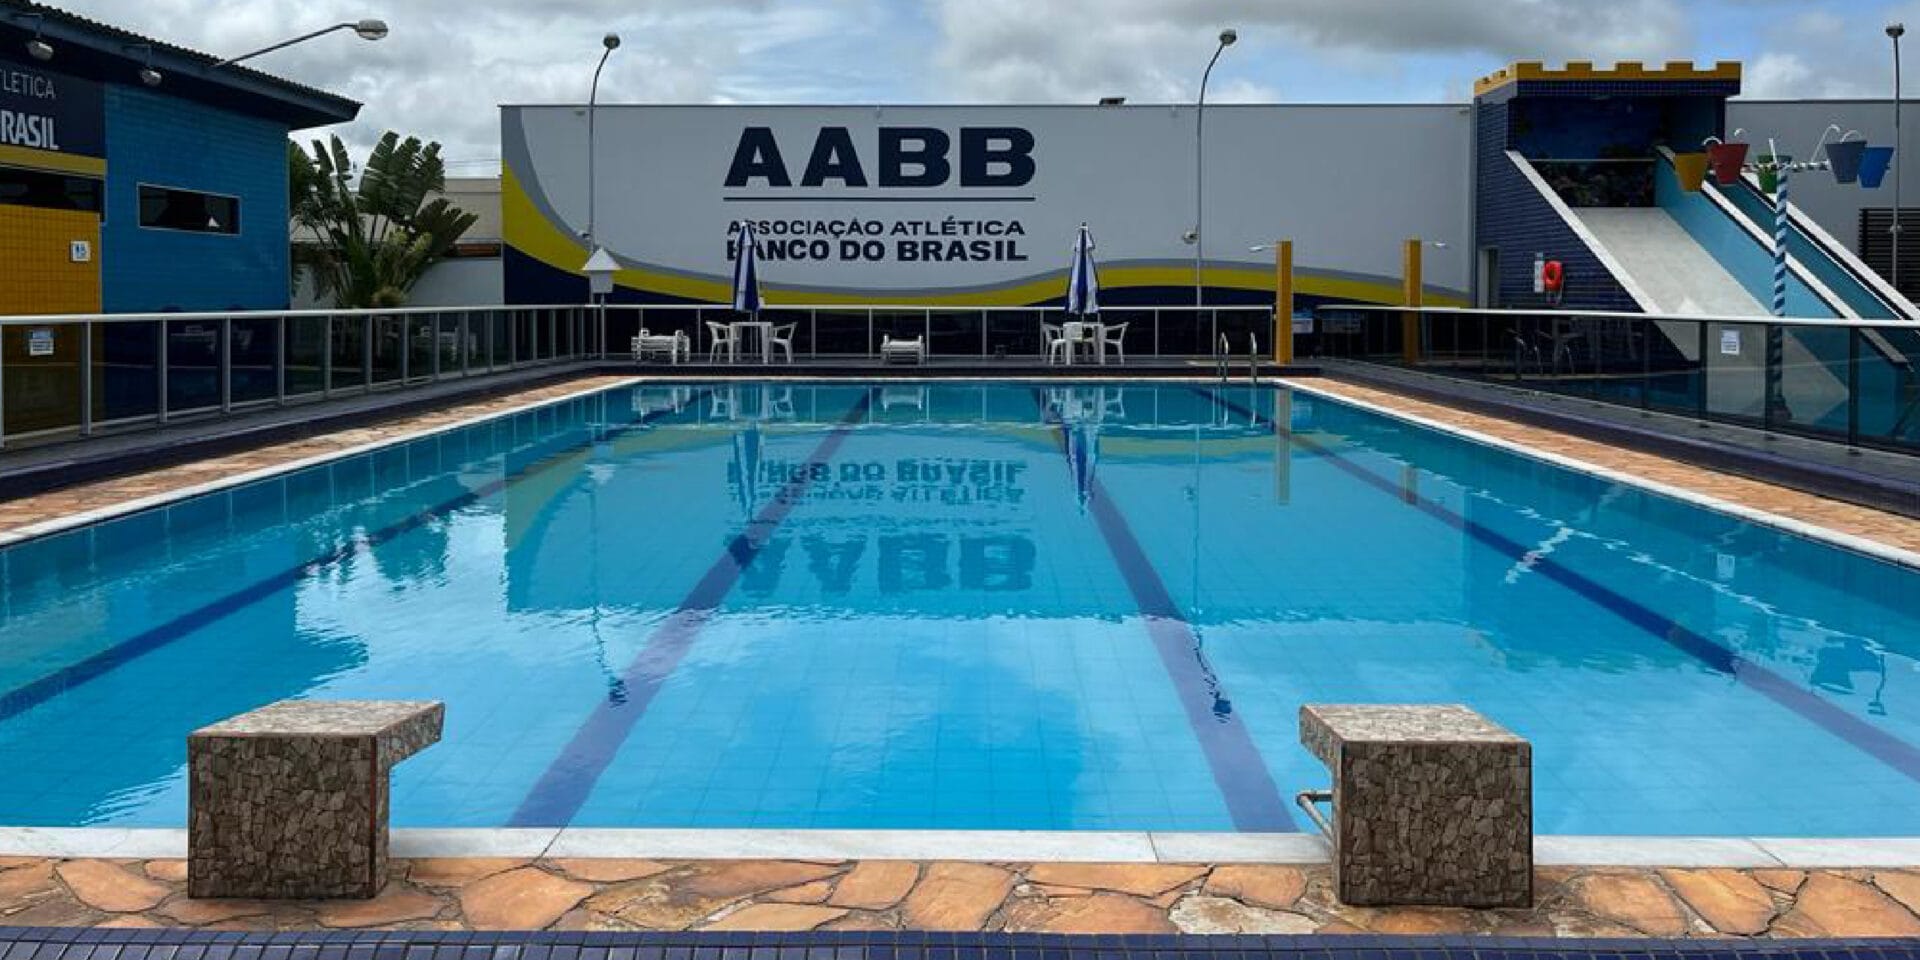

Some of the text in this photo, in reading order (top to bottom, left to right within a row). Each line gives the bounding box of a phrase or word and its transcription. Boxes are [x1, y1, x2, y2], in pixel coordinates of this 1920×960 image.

[0, 68, 56, 99] LETICA
[723, 126, 1036, 187] AABB
[890, 215, 1026, 236] ATLÉTICA
[840, 240, 885, 261] DO
[897, 240, 1029, 261] BRASIL
